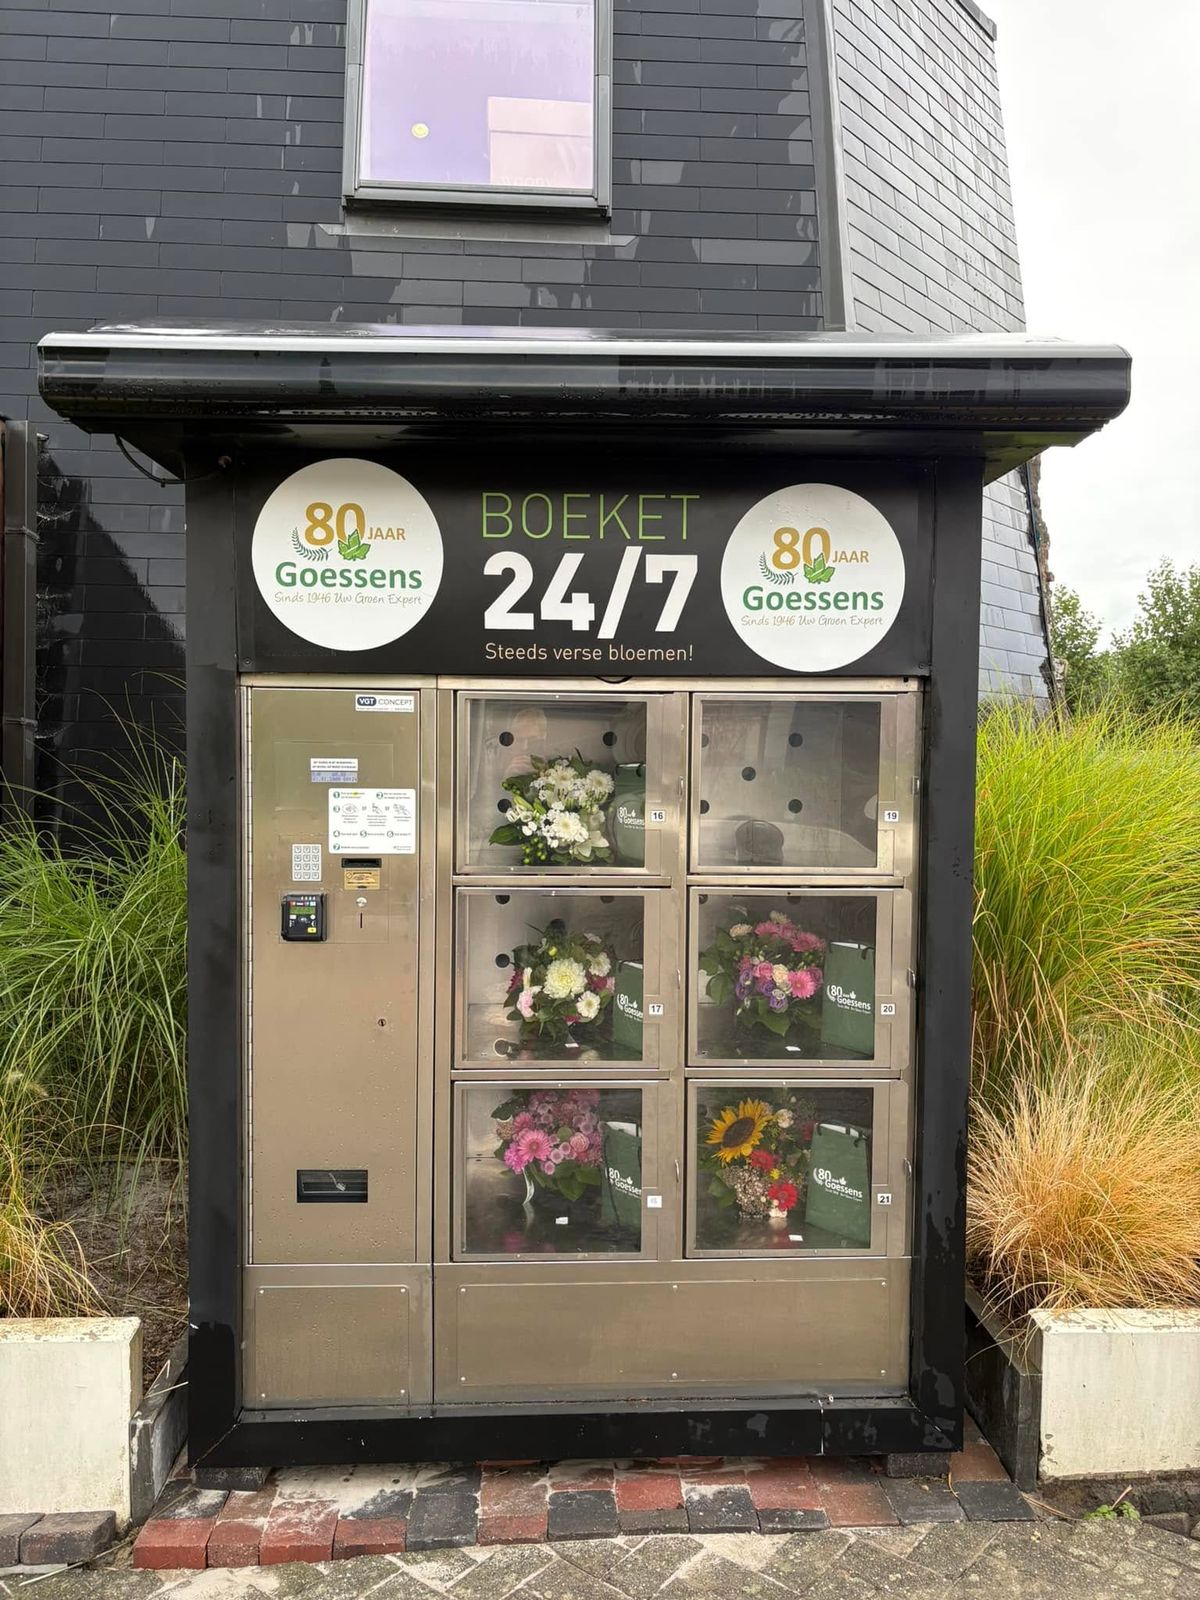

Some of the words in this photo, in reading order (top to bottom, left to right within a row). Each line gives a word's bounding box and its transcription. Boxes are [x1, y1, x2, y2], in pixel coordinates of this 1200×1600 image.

[482, 492, 700, 540] BOEKET
[304, 502, 366, 546] 80
[367, 527, 406, 541] JAAR
[771, 527, 831, 570] 80
[832, 550, 869, 563] JAAR
[275, 561, 422, 589] Goessens
[274, 591, 304, 603] Sinds
[307, 592, 331, 604] 1946
[334, 592, 352, 604] Uw
[355, 592, 385, 604] Groen
[388, 593, 422, 608] Expert
[483, 546, 698, 639] 24/7
[743, 585, 884, 611] Goessens
[740, 615, 769, 626] Sinds
[772, 615, 796, 626] 1946
[798, 615, 815, 626] Uw
[818, 614, 847, 626] Groen
[850, 615, 883, 628] Expert
[485, 642, 548, 660] Steeds
[553, 647, 602, 661] verse
[609, 644, 693, 661] bloemen!
[359, 697, 375, 705] VGT
[378, 698, 412, 706] CONCEPT
[653, 812, 664, 820] 16
[887, 811, 897, 820] 19
[830, 984, 843, 996] 80
[651, 1005, 661, 1013] 17
[837, 996, 871, 1010] Goessens
[883, 1005, 893, 1013] 20
[609, 1167, 620, 1179] 80
[818, 1168, 832, 1181] 80
[825, 1179, 863, 1198] Goessens
[879, 1195, 890, 1203] 21
